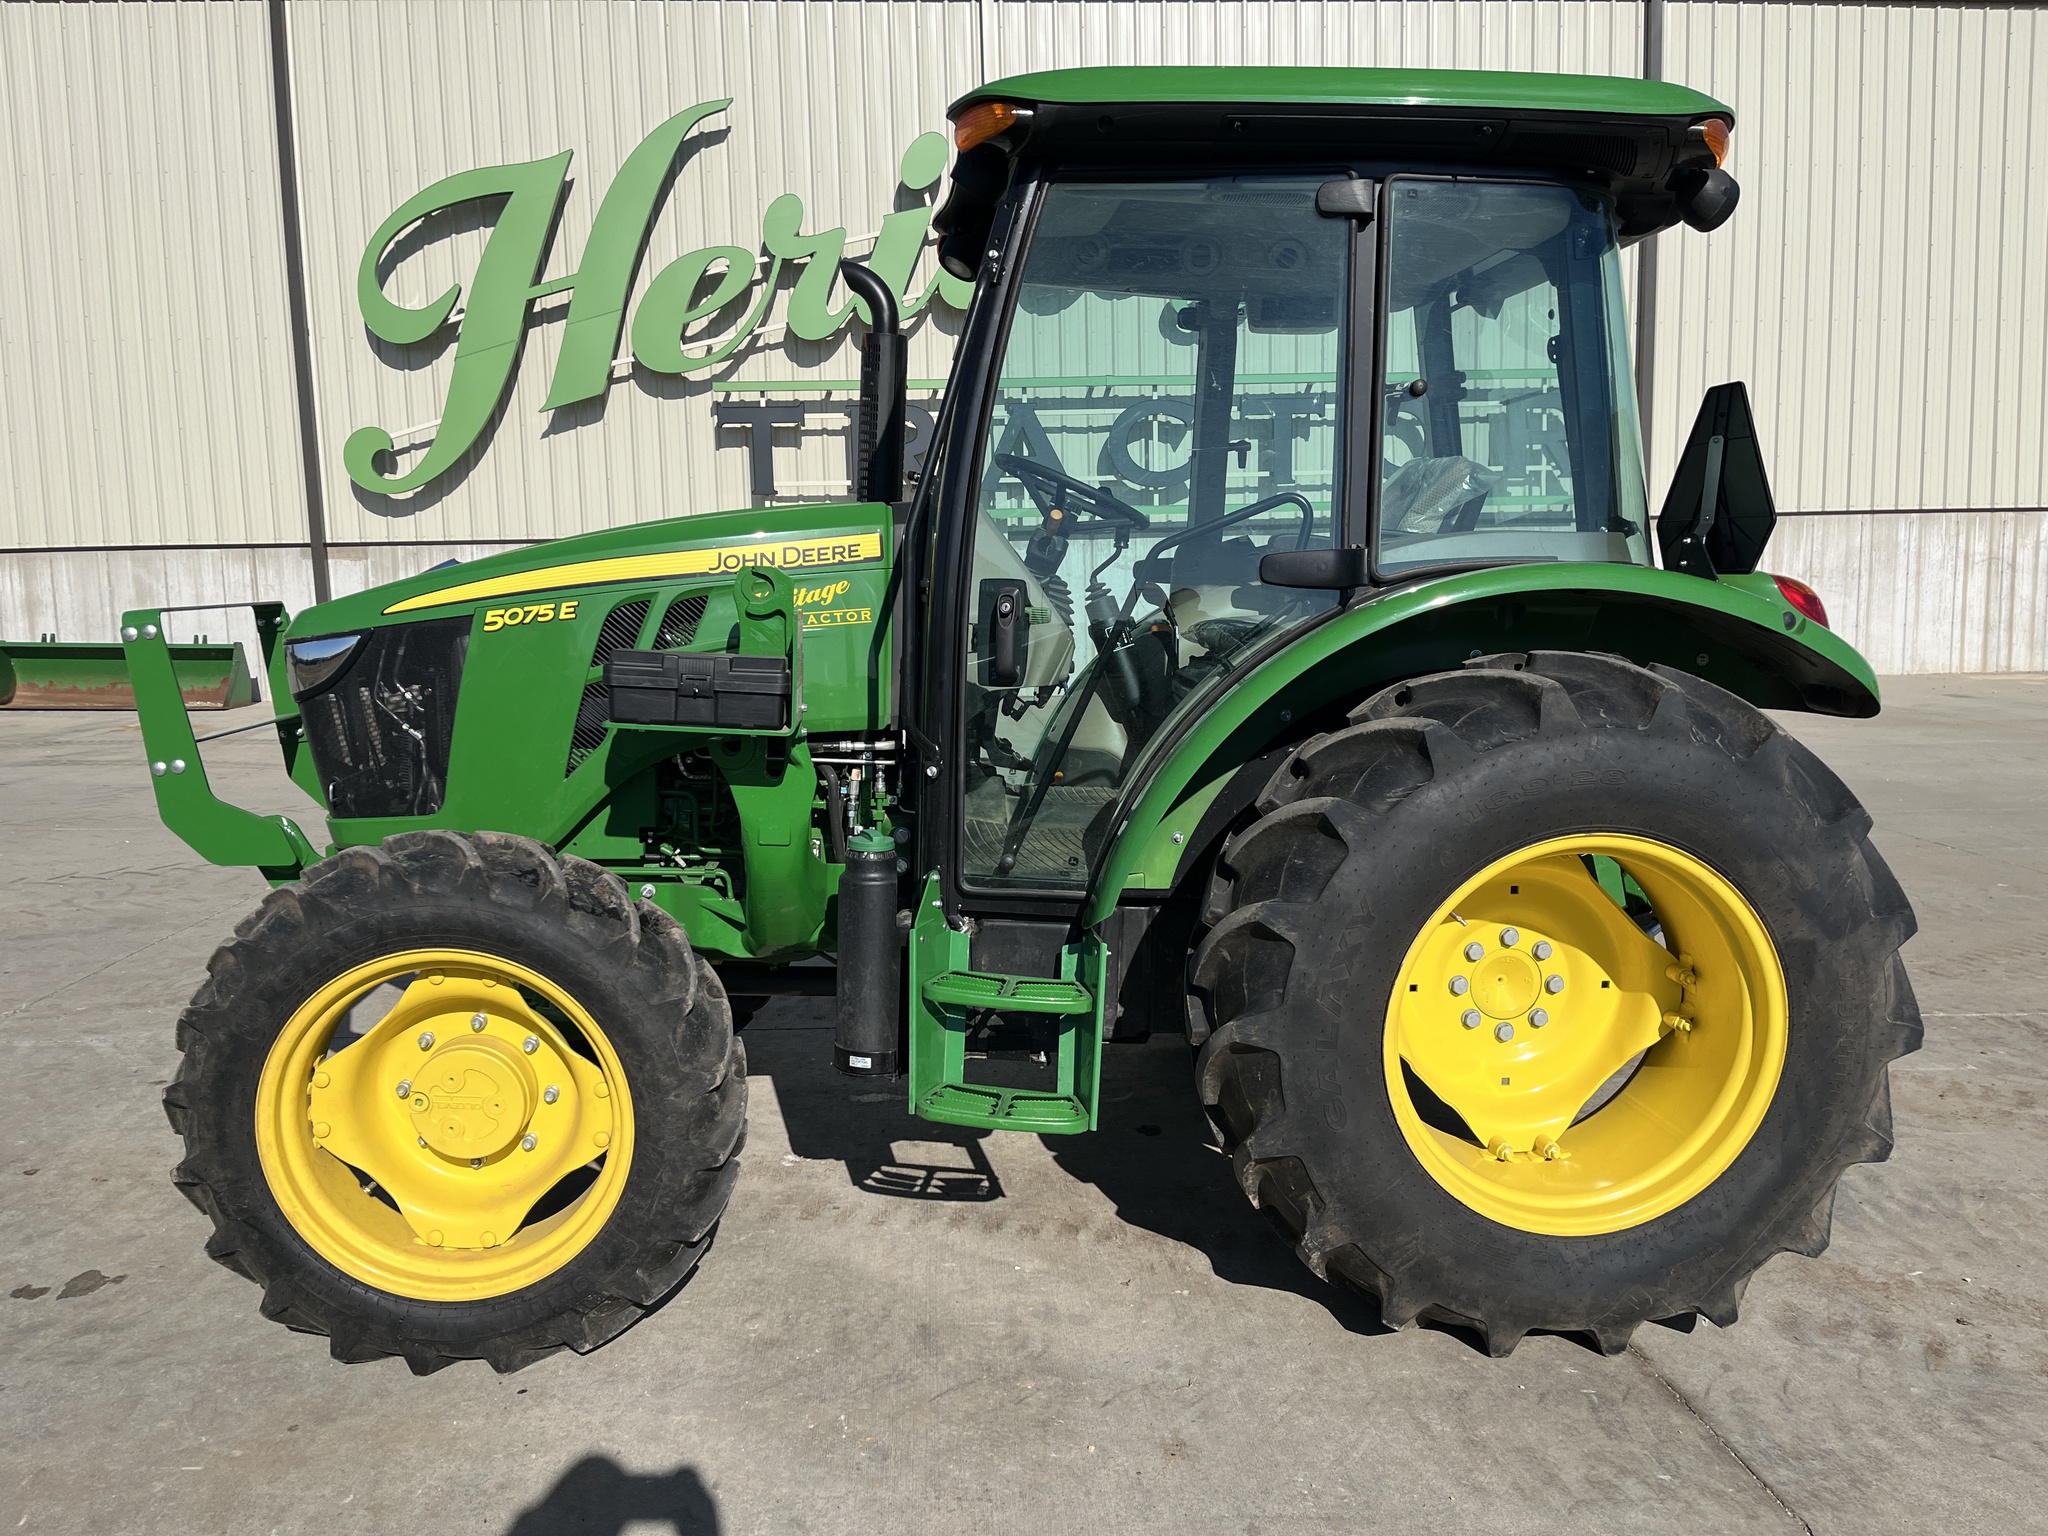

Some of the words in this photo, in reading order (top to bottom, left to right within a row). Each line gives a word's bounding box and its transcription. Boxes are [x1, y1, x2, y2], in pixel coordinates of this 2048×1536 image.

[344, 98, 977, 494] Heri
[708, 551, 776, 571] JOHN
[783, 544, 861, 567] DEERE
[483, 603, 556, 632] 5075
[558, 601, 579, 620] E
[807, 611, 872, 625] ACTOR
[1315, 899, 1376, 1131] GALAXY
